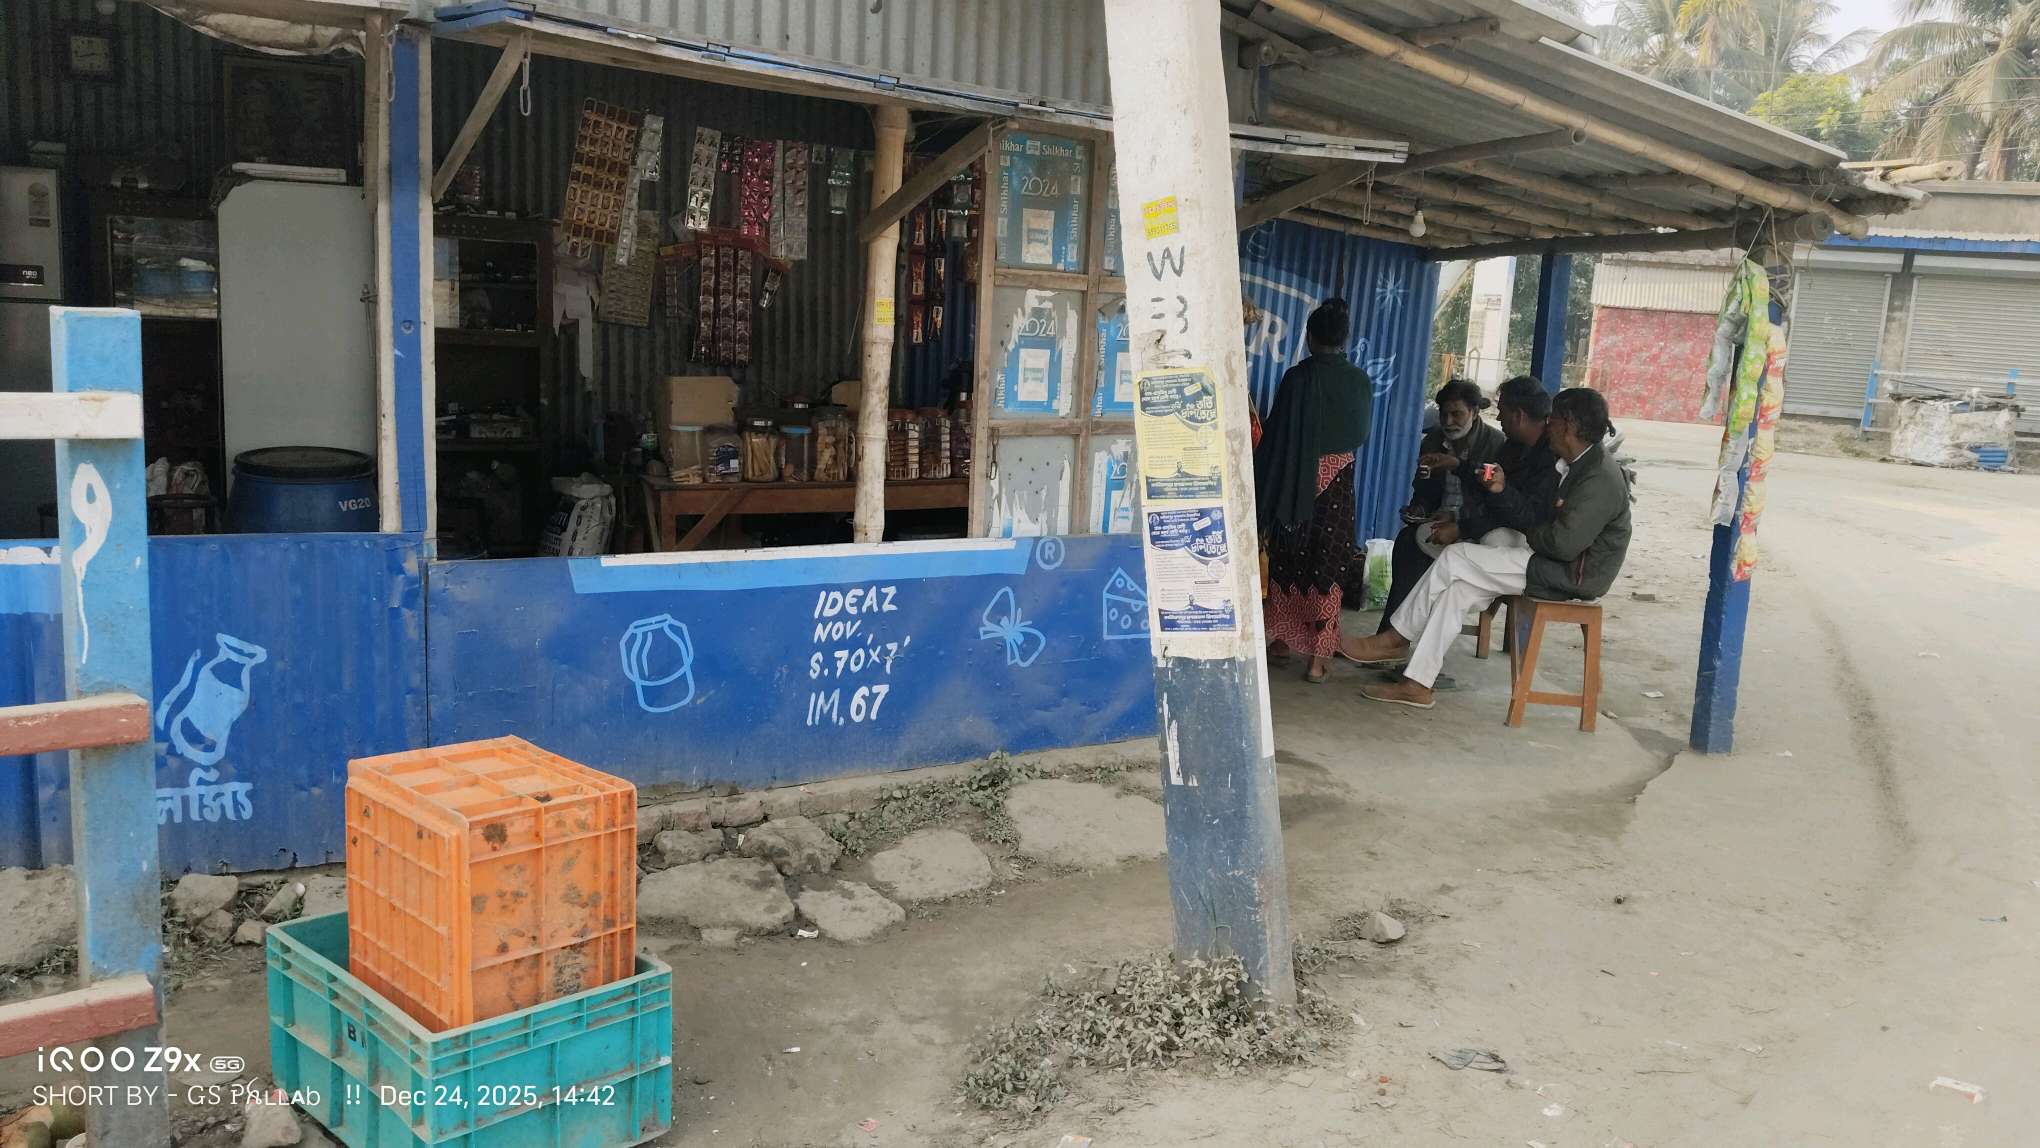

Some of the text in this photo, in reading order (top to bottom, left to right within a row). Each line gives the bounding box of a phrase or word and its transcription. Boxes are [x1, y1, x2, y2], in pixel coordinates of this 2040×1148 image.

[1041, 145, 1074, 157] Shikhar
[1021, 175, 1061, 199] 2024
[1018, 317, 1057, 337] 2024
[814, 585, 898, 619] IDEAZ
